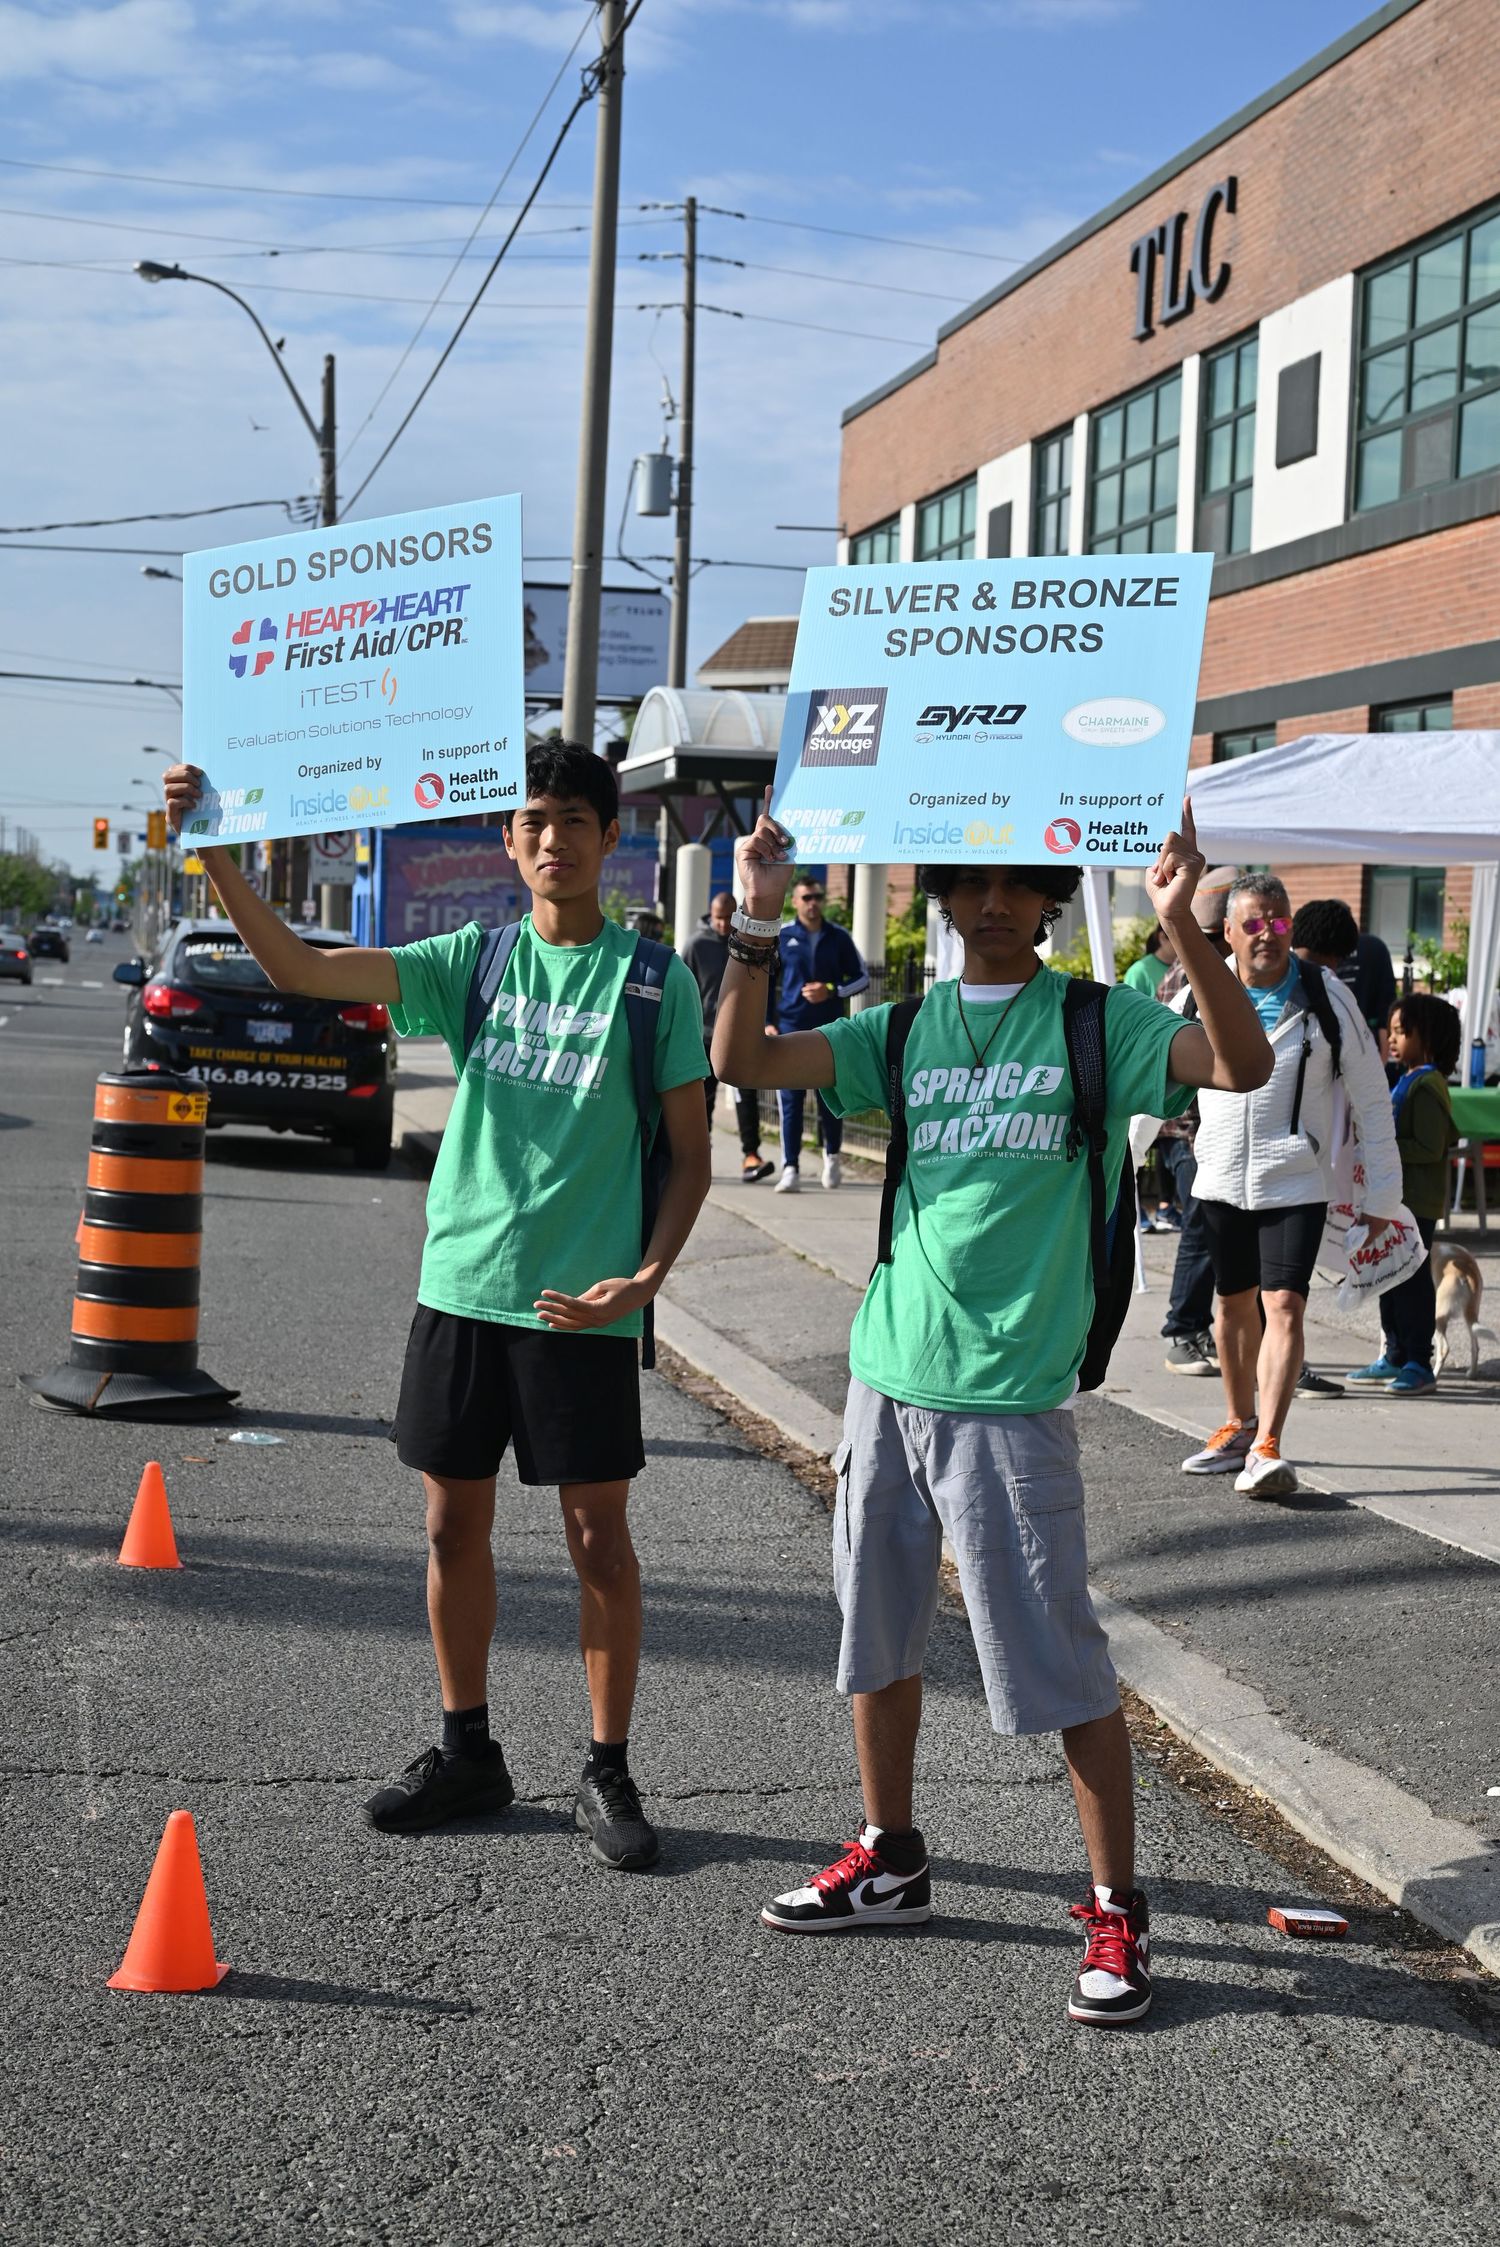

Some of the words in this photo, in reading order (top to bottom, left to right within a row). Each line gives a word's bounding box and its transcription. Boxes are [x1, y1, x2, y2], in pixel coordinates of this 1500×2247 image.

[1130, 176, 1238, 343] TLC
[209, 558, 297, 599] GOLD
[307, 523, 493, 582] SPONSORS
[828, 583, 959, 617] SILVER
[972, 581, 998, 611] &
[1011, 577, 1180, 610] BRONZE
[285, 637, 345, 671] First
[350, 618, 464, 661] Aid/CPR
[884, 622, 1104, 658] SPONSORS
[301, 679, 376, 709] iTEST
[227, 727, 306, 750] Evaluation
[308, 717, 381, 738] Solutions
[385, 704, 474, 729] Technology
[812, 704, 878, 735] XYZ
[916, 704, 1027, 733] GYRO
[422, 748, 434, 762] In
[438, 741, 490, 761] support
[494, 737, 508, 751] of
[810, 738, 873, 754] Storage
[298, 757, 363, 779] Organized
[366, 756, 382, 771] by
[449, 768, 499, 787] Health
[449, 788, 477, 803] Out
[480, 784, 517, 801] Loud
[909, 792, 987, 809] Organized
[991, 792, 1010, 808] by
[1060, 792, 1074, 806] In
[1079, 793, 1142, 808] support
[1147, 792, 1164, 806] of
[208, 812, 268, 836] ACTION!
[781, 808, 843, 828] SPRING
[1088, 821, 1148, 837] Health
[797, 833, 866, 854] ACTION!
[1086, 837, 1126, 853] Out
[486, 992, 577, 1037] PRING
[520, 1032, 545, 1048] INTO
[190, 1047, 213, 1059] TAKE
[216, 1049, 256, 1062] CHARGE
[259, 1052, 272, 1063] OF
[274, 1053, 302, 1065] YOUR
[303, 1055, 347, 1070] HEALTH!
[487, 1041, 609, 1090] ACTION!
[188, 1066, 347, 1091] 416.849.7325
[503, 1078, 517, 1087] FOR
[517, 1080, 542, 1091] YOUTH
[544, 1085, 573, 1096] MENTAL
[908, 1062, 1023, 1108] SPRING
[968, 1101, 994, 1115] INTO
[940, 1112, 1068, 1153] ACTION!
[997, 1152, 1030, 1160] MENTAL
[1033, 1153, 1062, 1161] HEALTH
